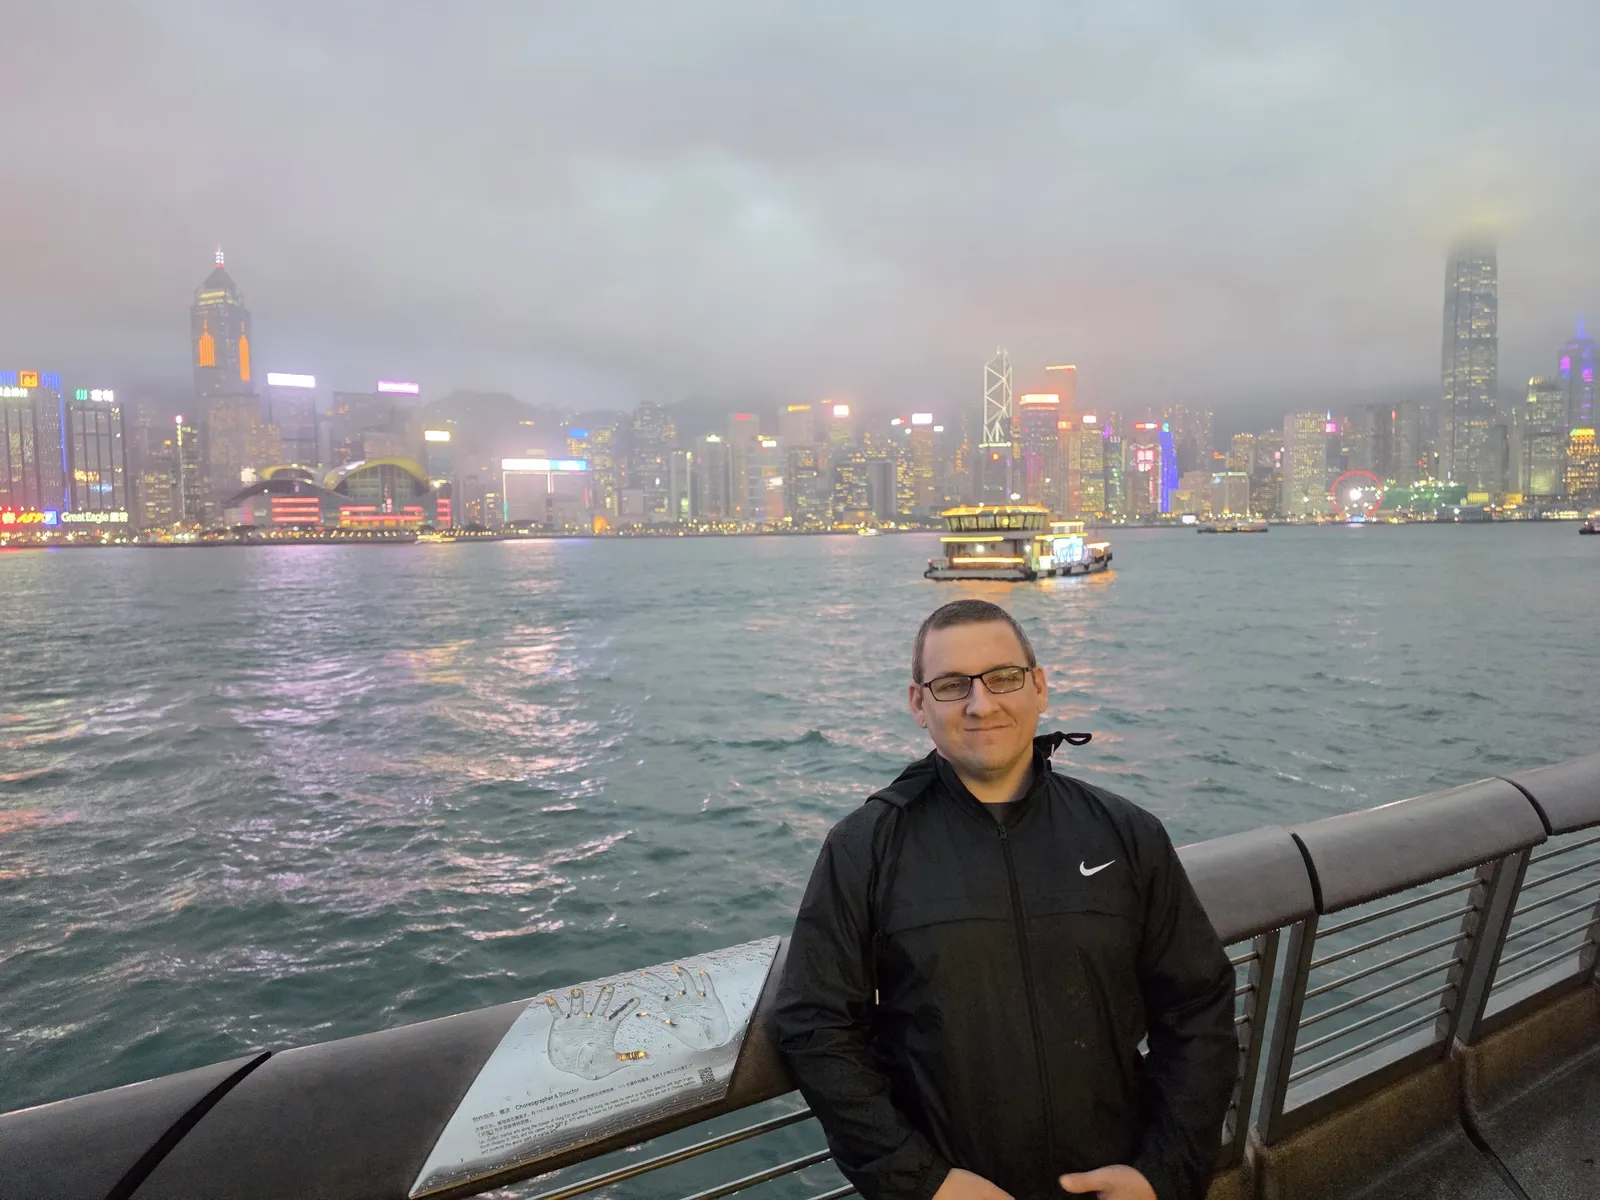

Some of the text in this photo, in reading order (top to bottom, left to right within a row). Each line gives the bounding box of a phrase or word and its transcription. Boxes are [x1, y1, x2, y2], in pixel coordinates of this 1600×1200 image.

[61, 511, 85, 523] Great
[85, 510, 108, 524] Eagle
[515, 1095, 553, 1110] Choreographer
[559, 1087, 579, 1097] Director
